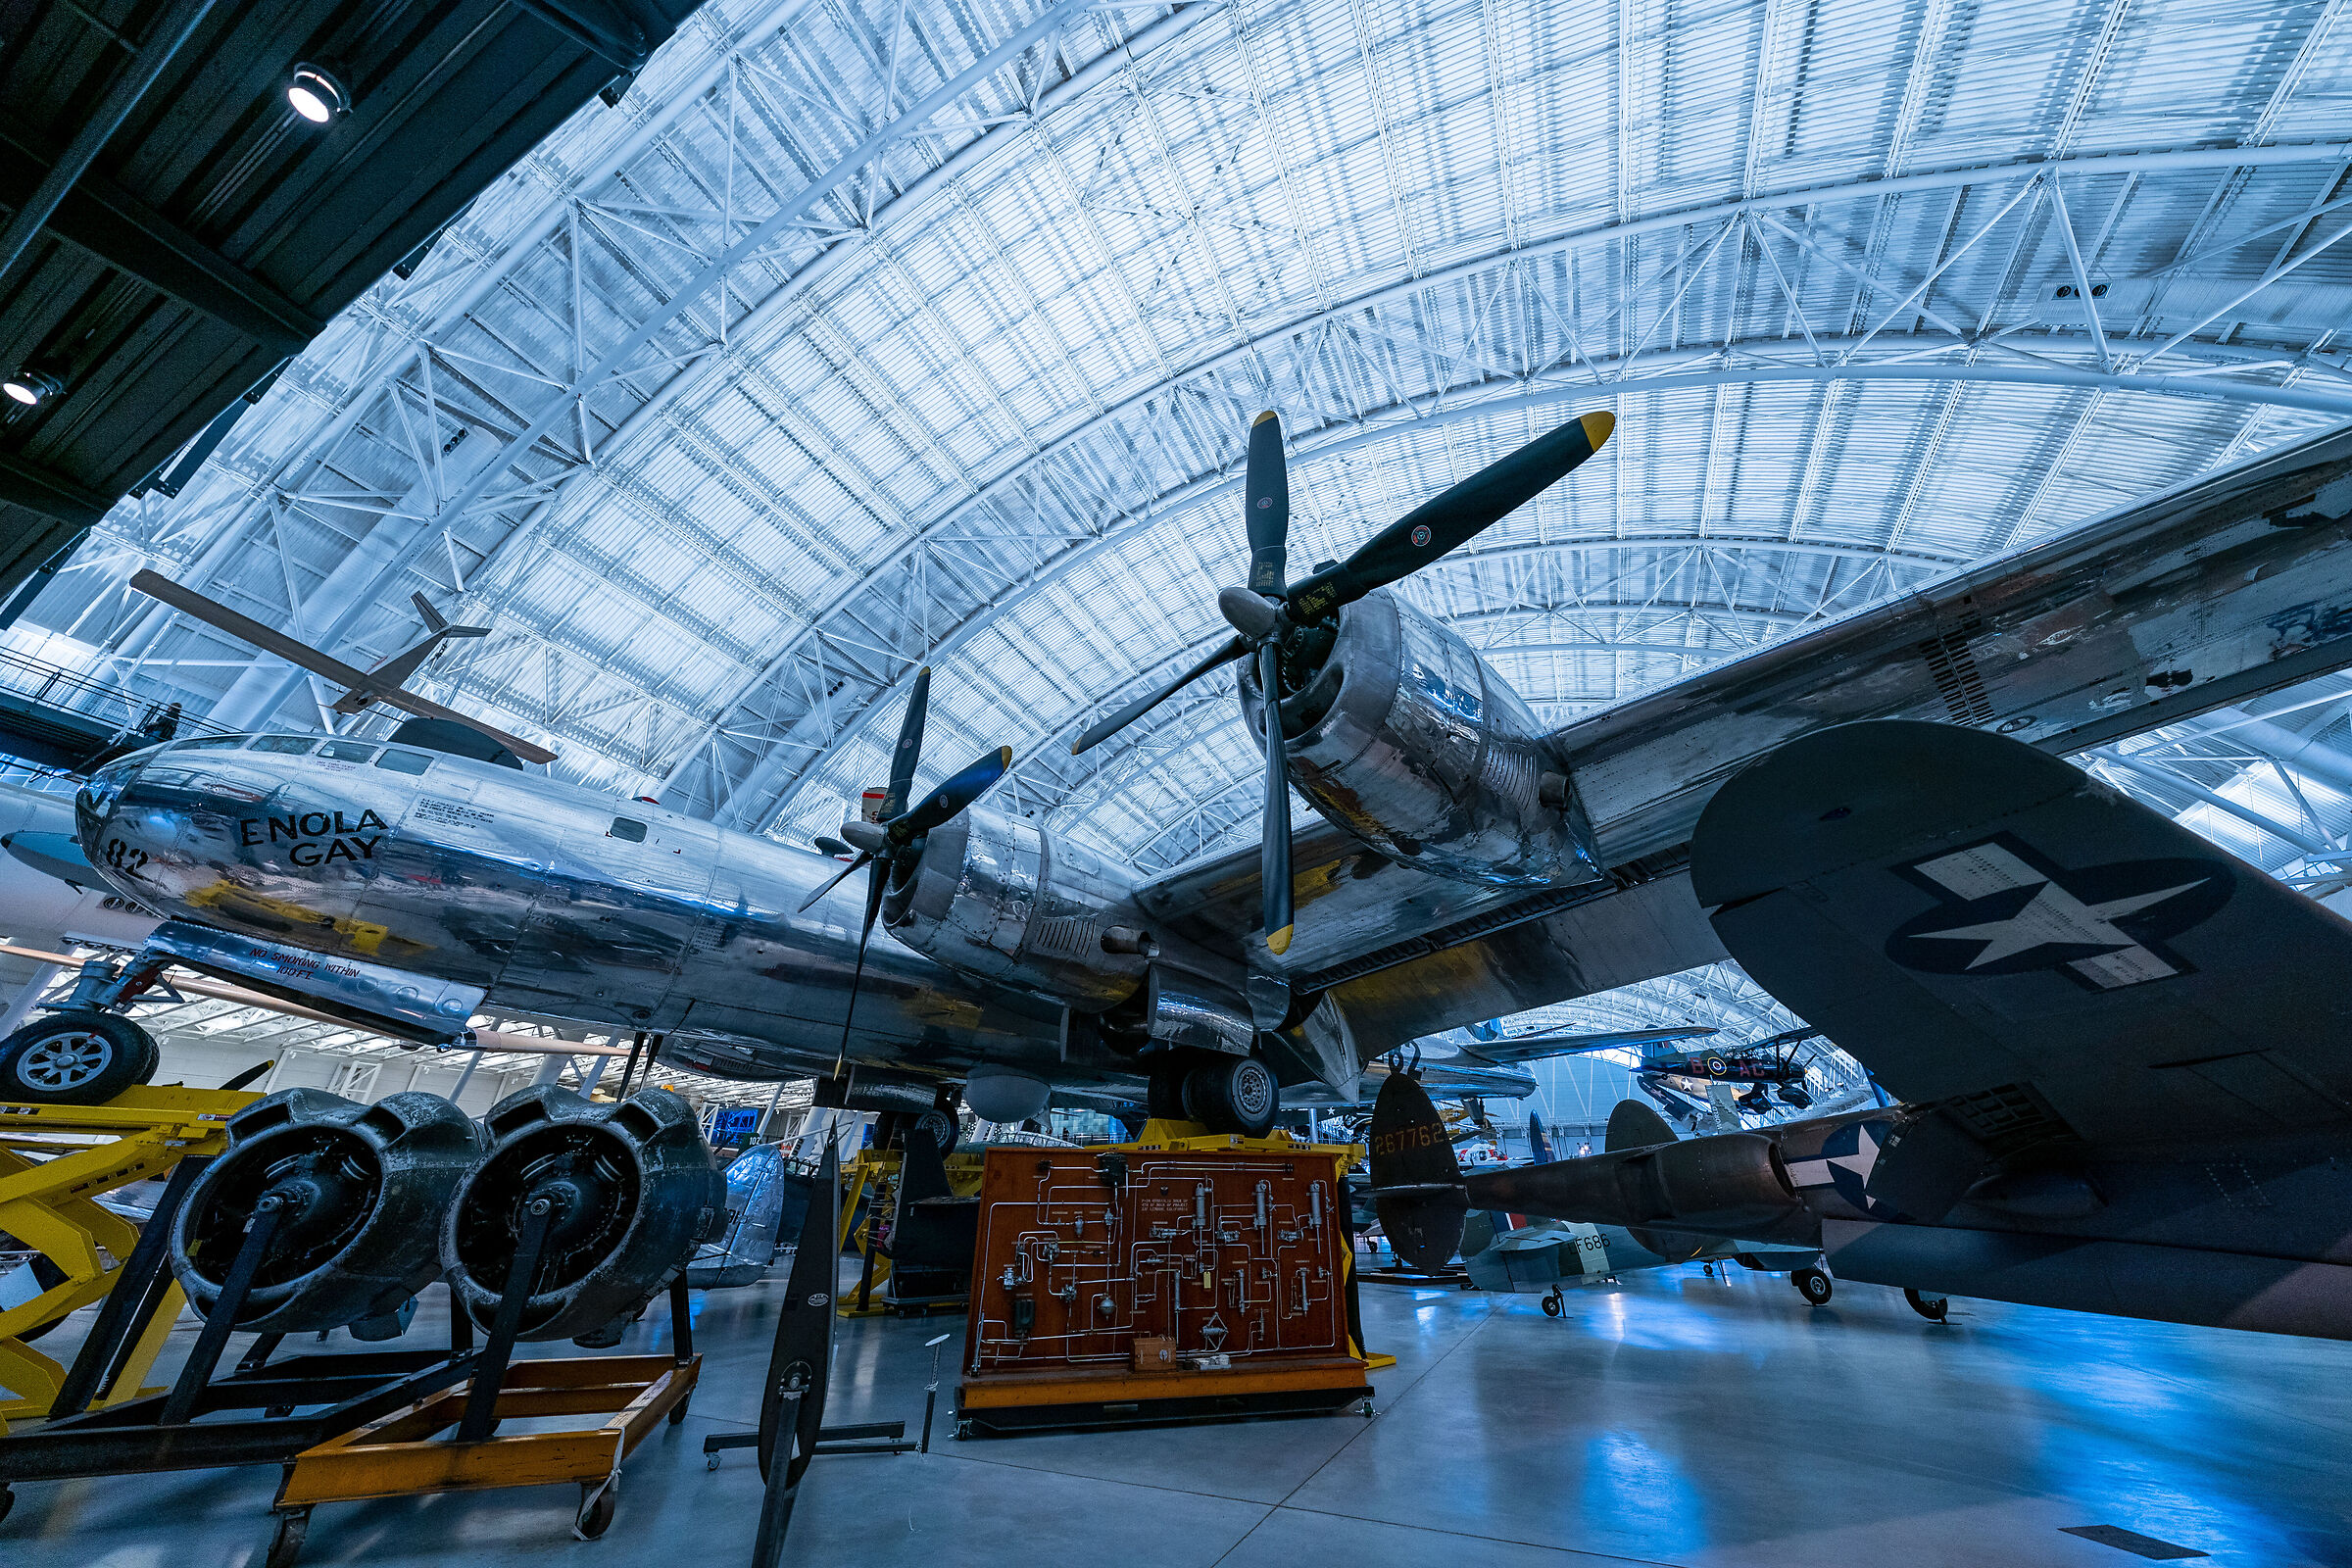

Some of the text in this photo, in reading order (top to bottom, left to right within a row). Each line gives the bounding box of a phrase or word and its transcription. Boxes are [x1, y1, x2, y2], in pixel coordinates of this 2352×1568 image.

[239, 808, 389, 847] ENOLA
[106, 838, 149, 880] 82
[289, 835, 381, 867] GAY
[249, 948, 361, 978] NO SMOKING WITHIN
[1689, 1056, 1704, 1075] B
[1374, 1122, 1445, 1155] 267762
